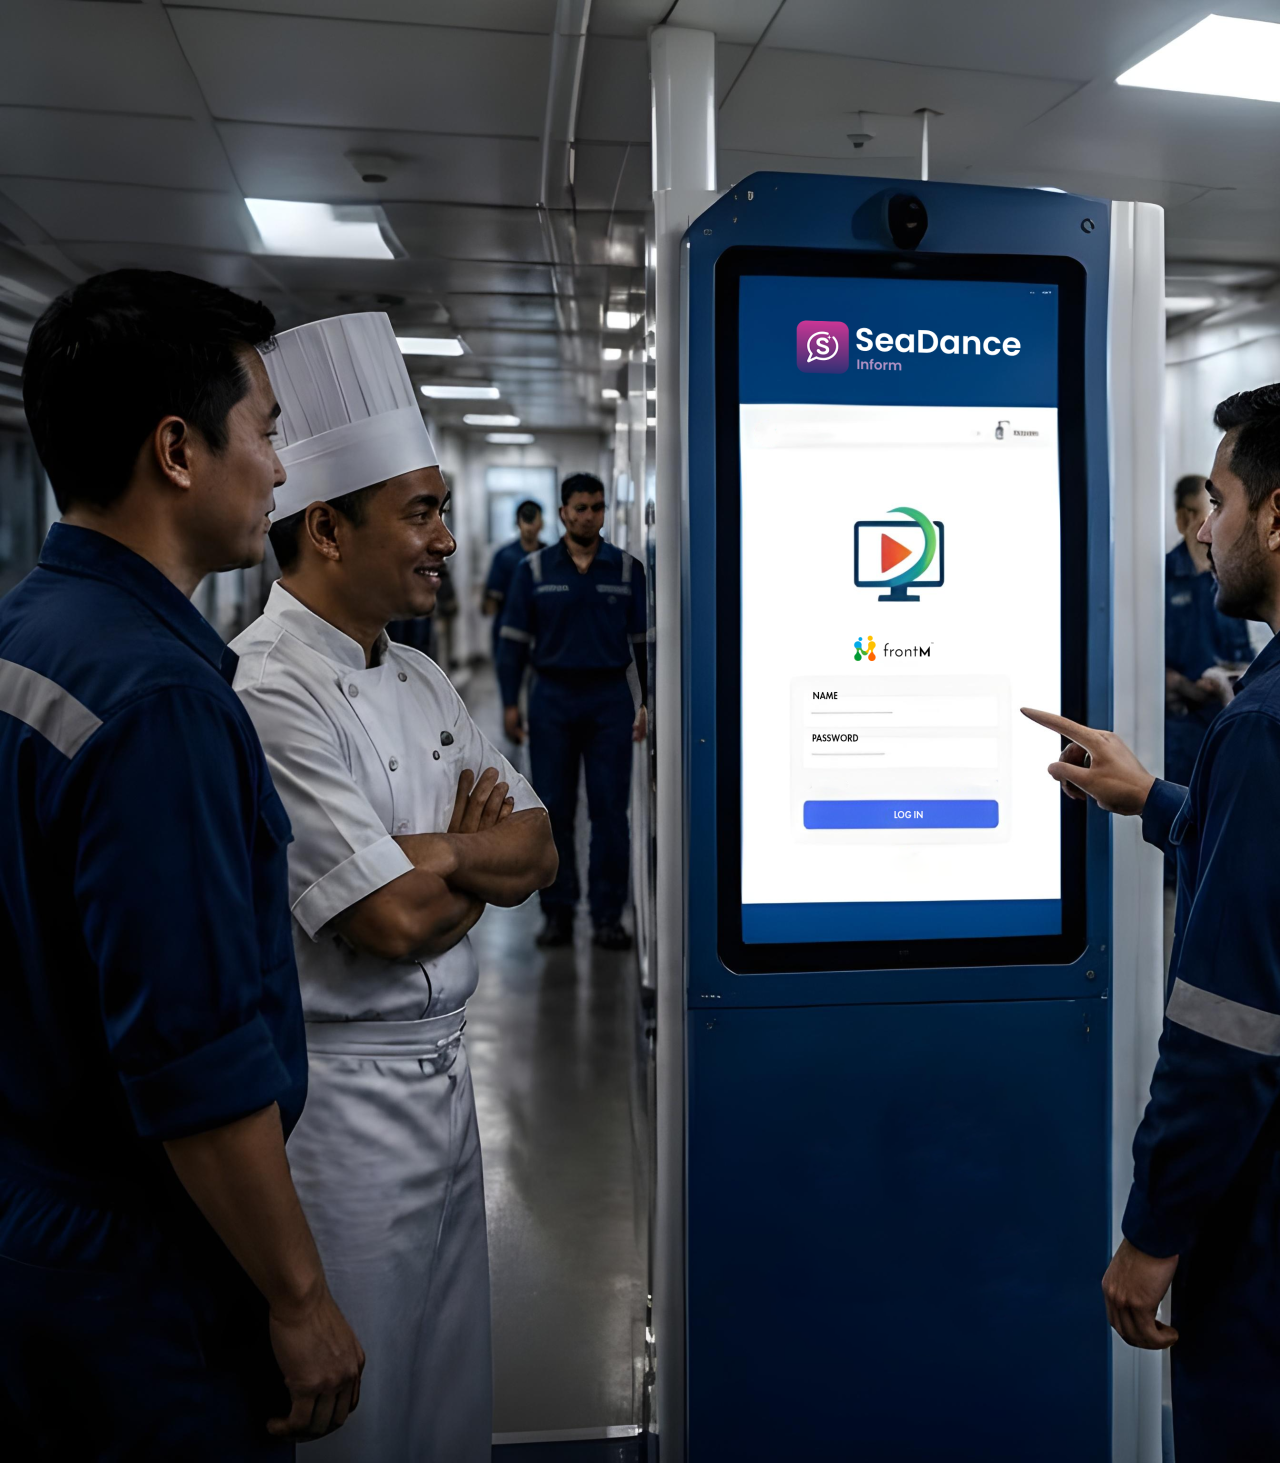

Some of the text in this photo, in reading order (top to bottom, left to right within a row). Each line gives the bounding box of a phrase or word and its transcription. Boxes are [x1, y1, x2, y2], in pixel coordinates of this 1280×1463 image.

[815, 337, 830, 355] S
[855, 327, 1022, 357] SeaDance
[856, 358, 902, 371] Inform
[883, 642, 931, 657] frontM
[812, 691, 838, 700] NAME
[812, 734, 859, 742] PASSWORD
[893, 811, 924, 819] LOG IN
